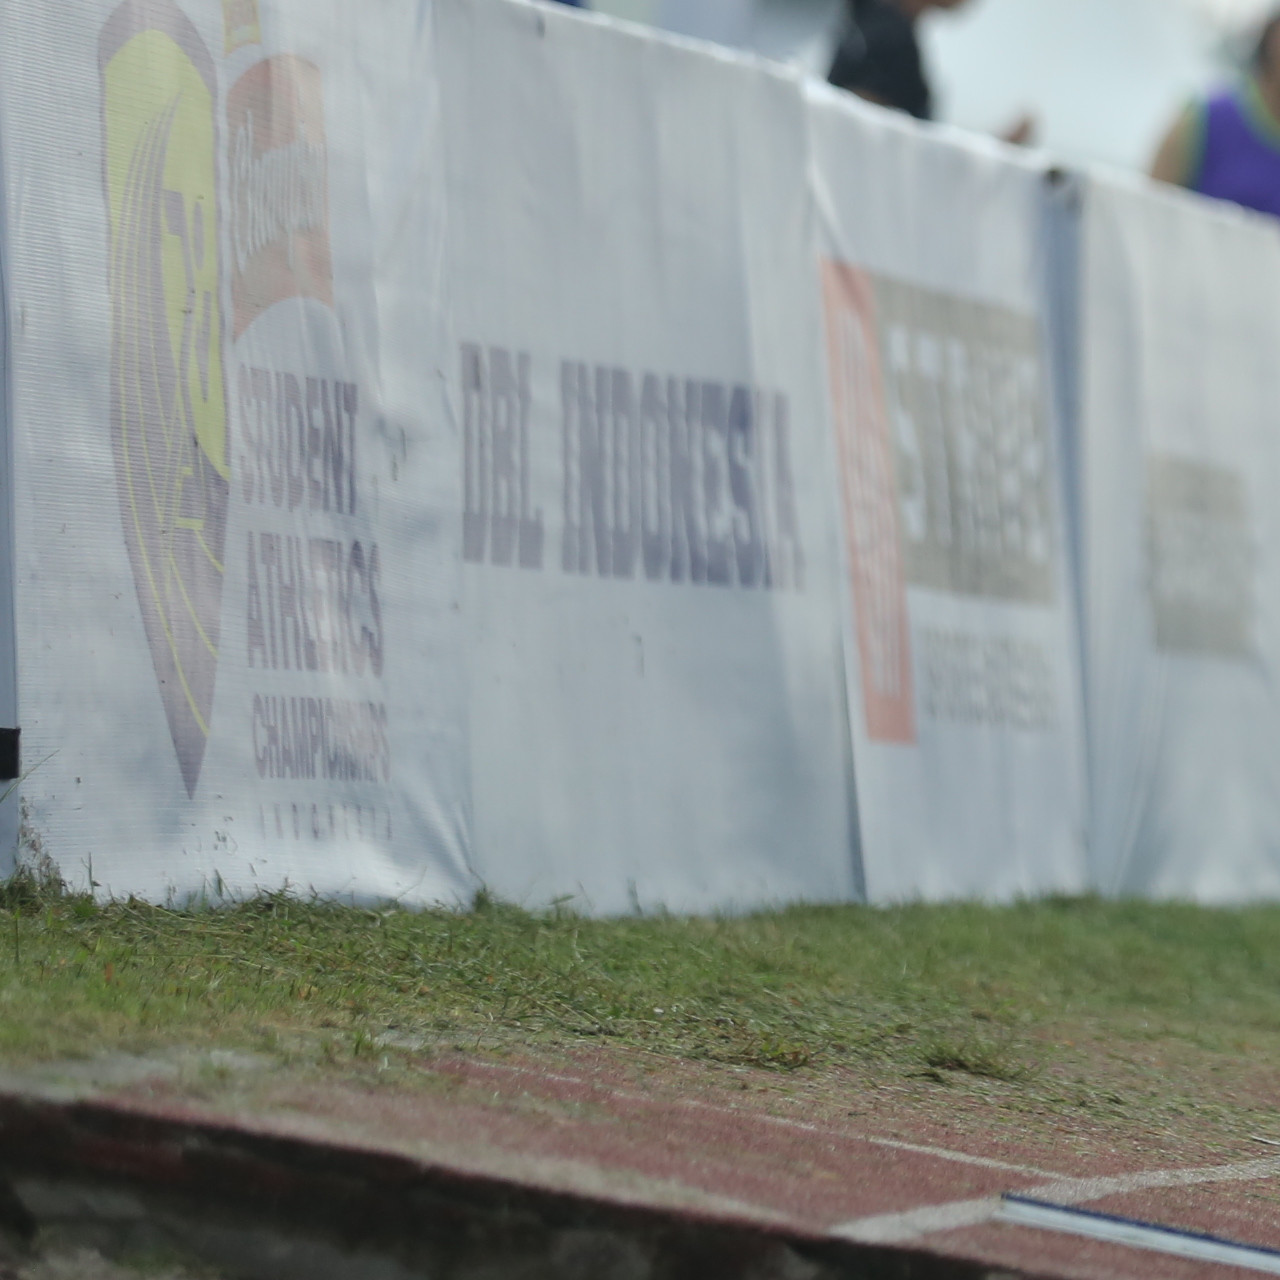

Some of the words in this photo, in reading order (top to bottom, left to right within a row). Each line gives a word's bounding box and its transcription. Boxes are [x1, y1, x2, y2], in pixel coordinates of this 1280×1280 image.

[237, 362, 358, 516] STUDENT
[459, 340, 545, 571] DBL
[560, 358, 806, 593] INDONESIA
[246, 530, 385, 679] ATHLETICS
[252, 692, 392, 784] CHAMPIONSHIPS
